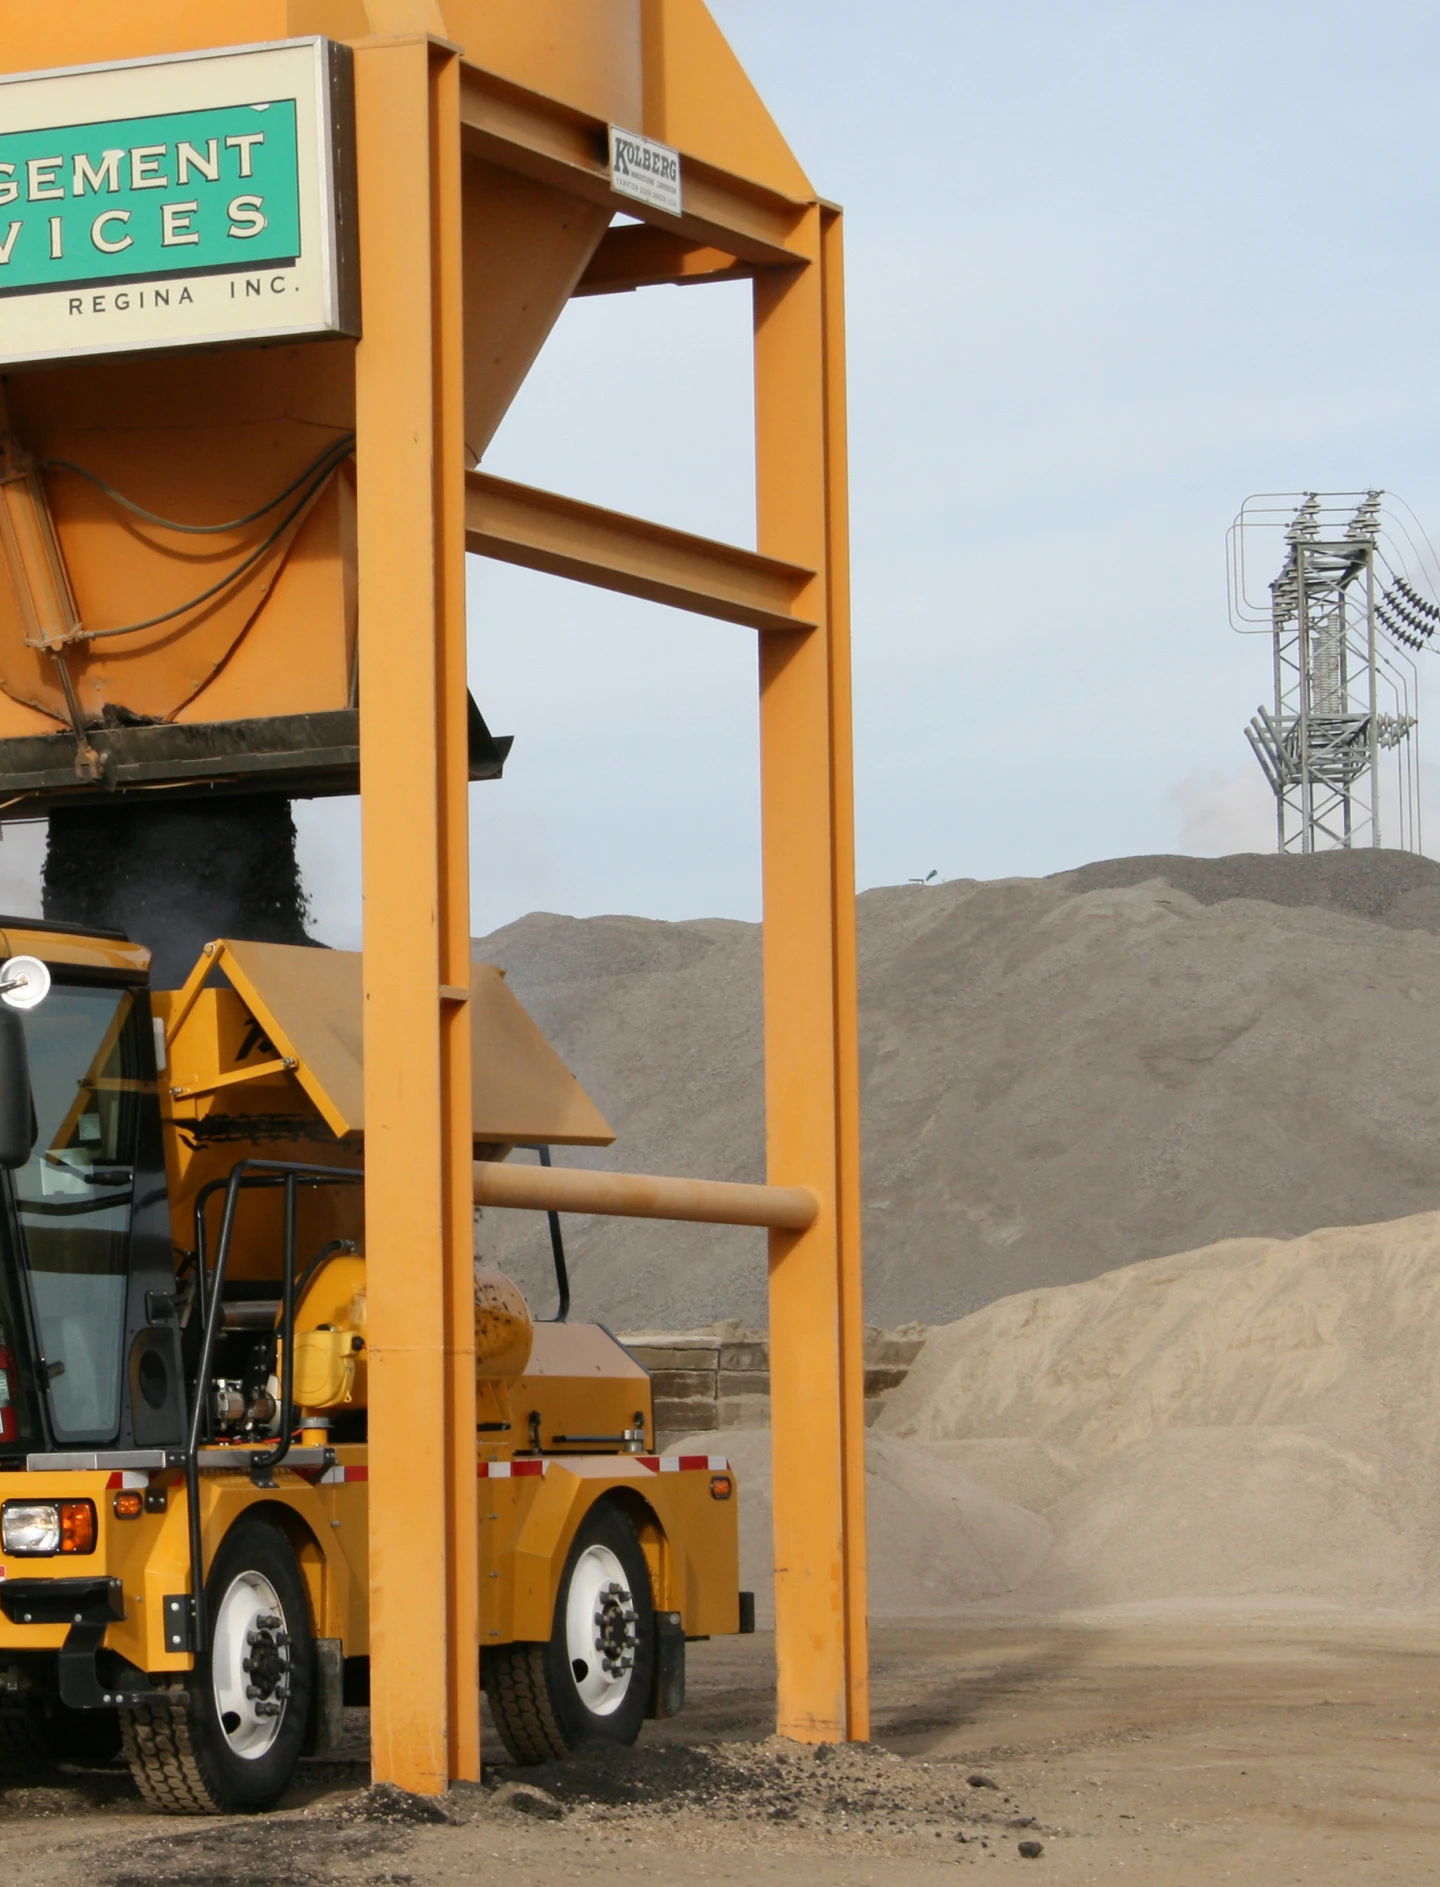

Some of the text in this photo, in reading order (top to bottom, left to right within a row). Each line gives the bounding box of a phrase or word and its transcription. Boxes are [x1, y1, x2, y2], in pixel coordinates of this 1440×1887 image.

[614, 137, 677, 182] KOLBERG
[69, 276, 300, 315] REGINA INC.
